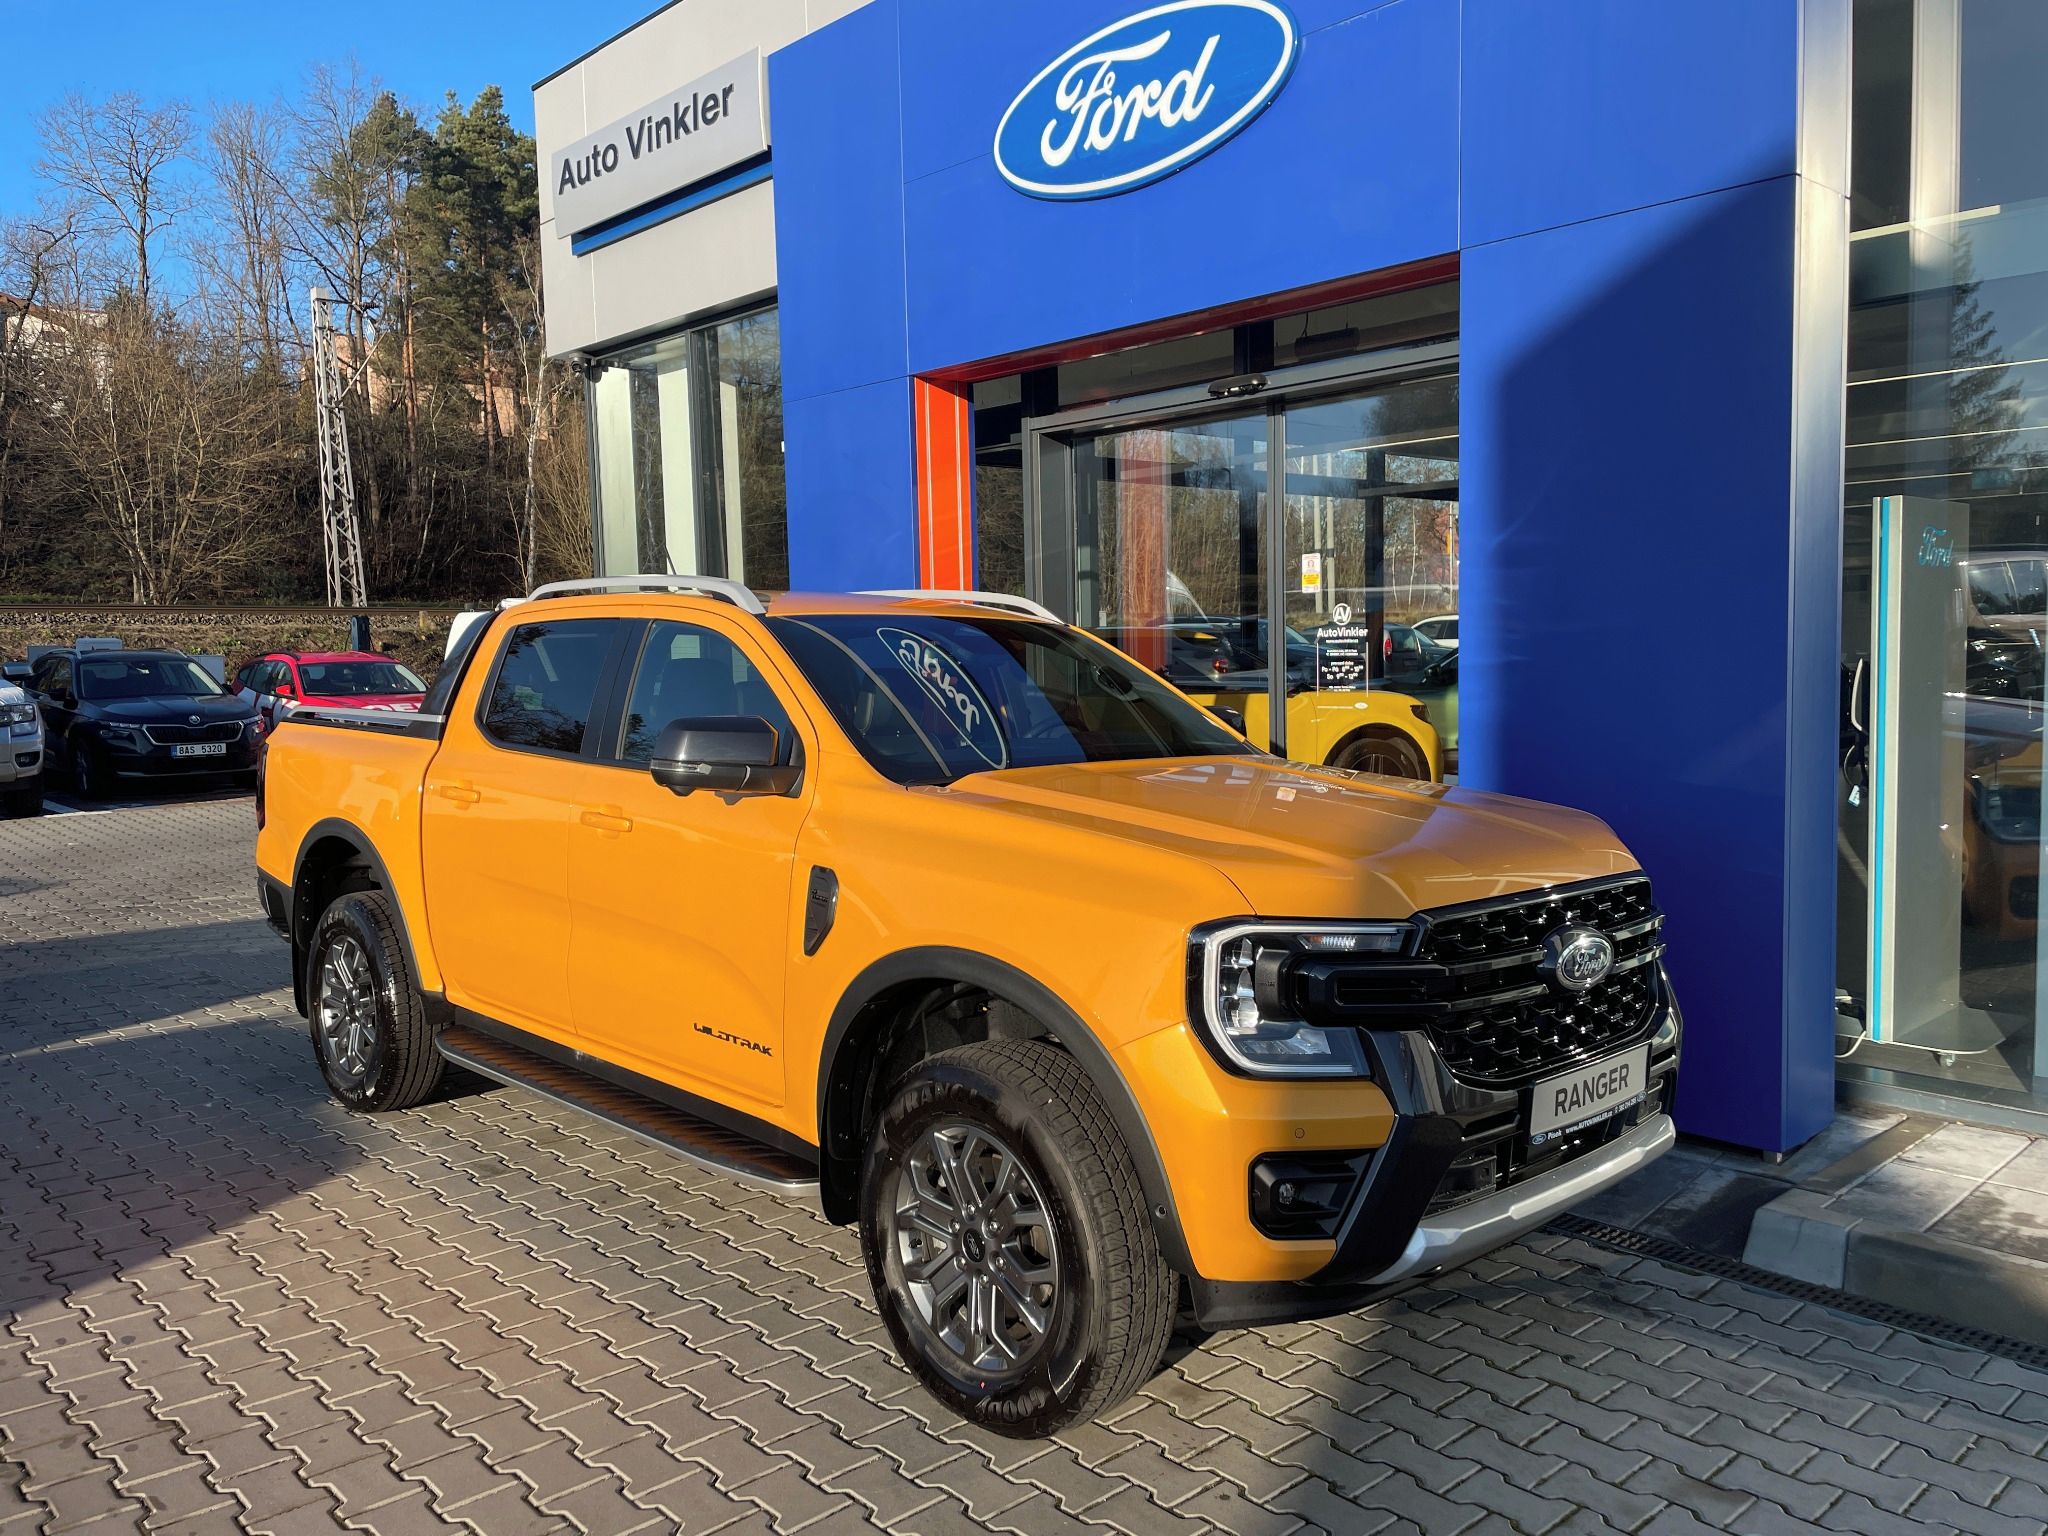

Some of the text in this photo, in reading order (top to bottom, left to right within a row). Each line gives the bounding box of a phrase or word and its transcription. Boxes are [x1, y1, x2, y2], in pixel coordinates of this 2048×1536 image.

[1040, 29, 1221, 168] Ford
[558, 82, 735, 196] Auto Vinkler
[1918, 525, 1954, 567] Ford
[1317, 626, 1368, 638] AutoVinkler
[178, 745, 196, 755] 8AS
[201, 744, 223, 754] 5320
[1573, 947, 1607, 978] Ford
[693, 1022, 774, 1058] WILDTRAK
[1554, 1063, 1630, 1117] RANGER
